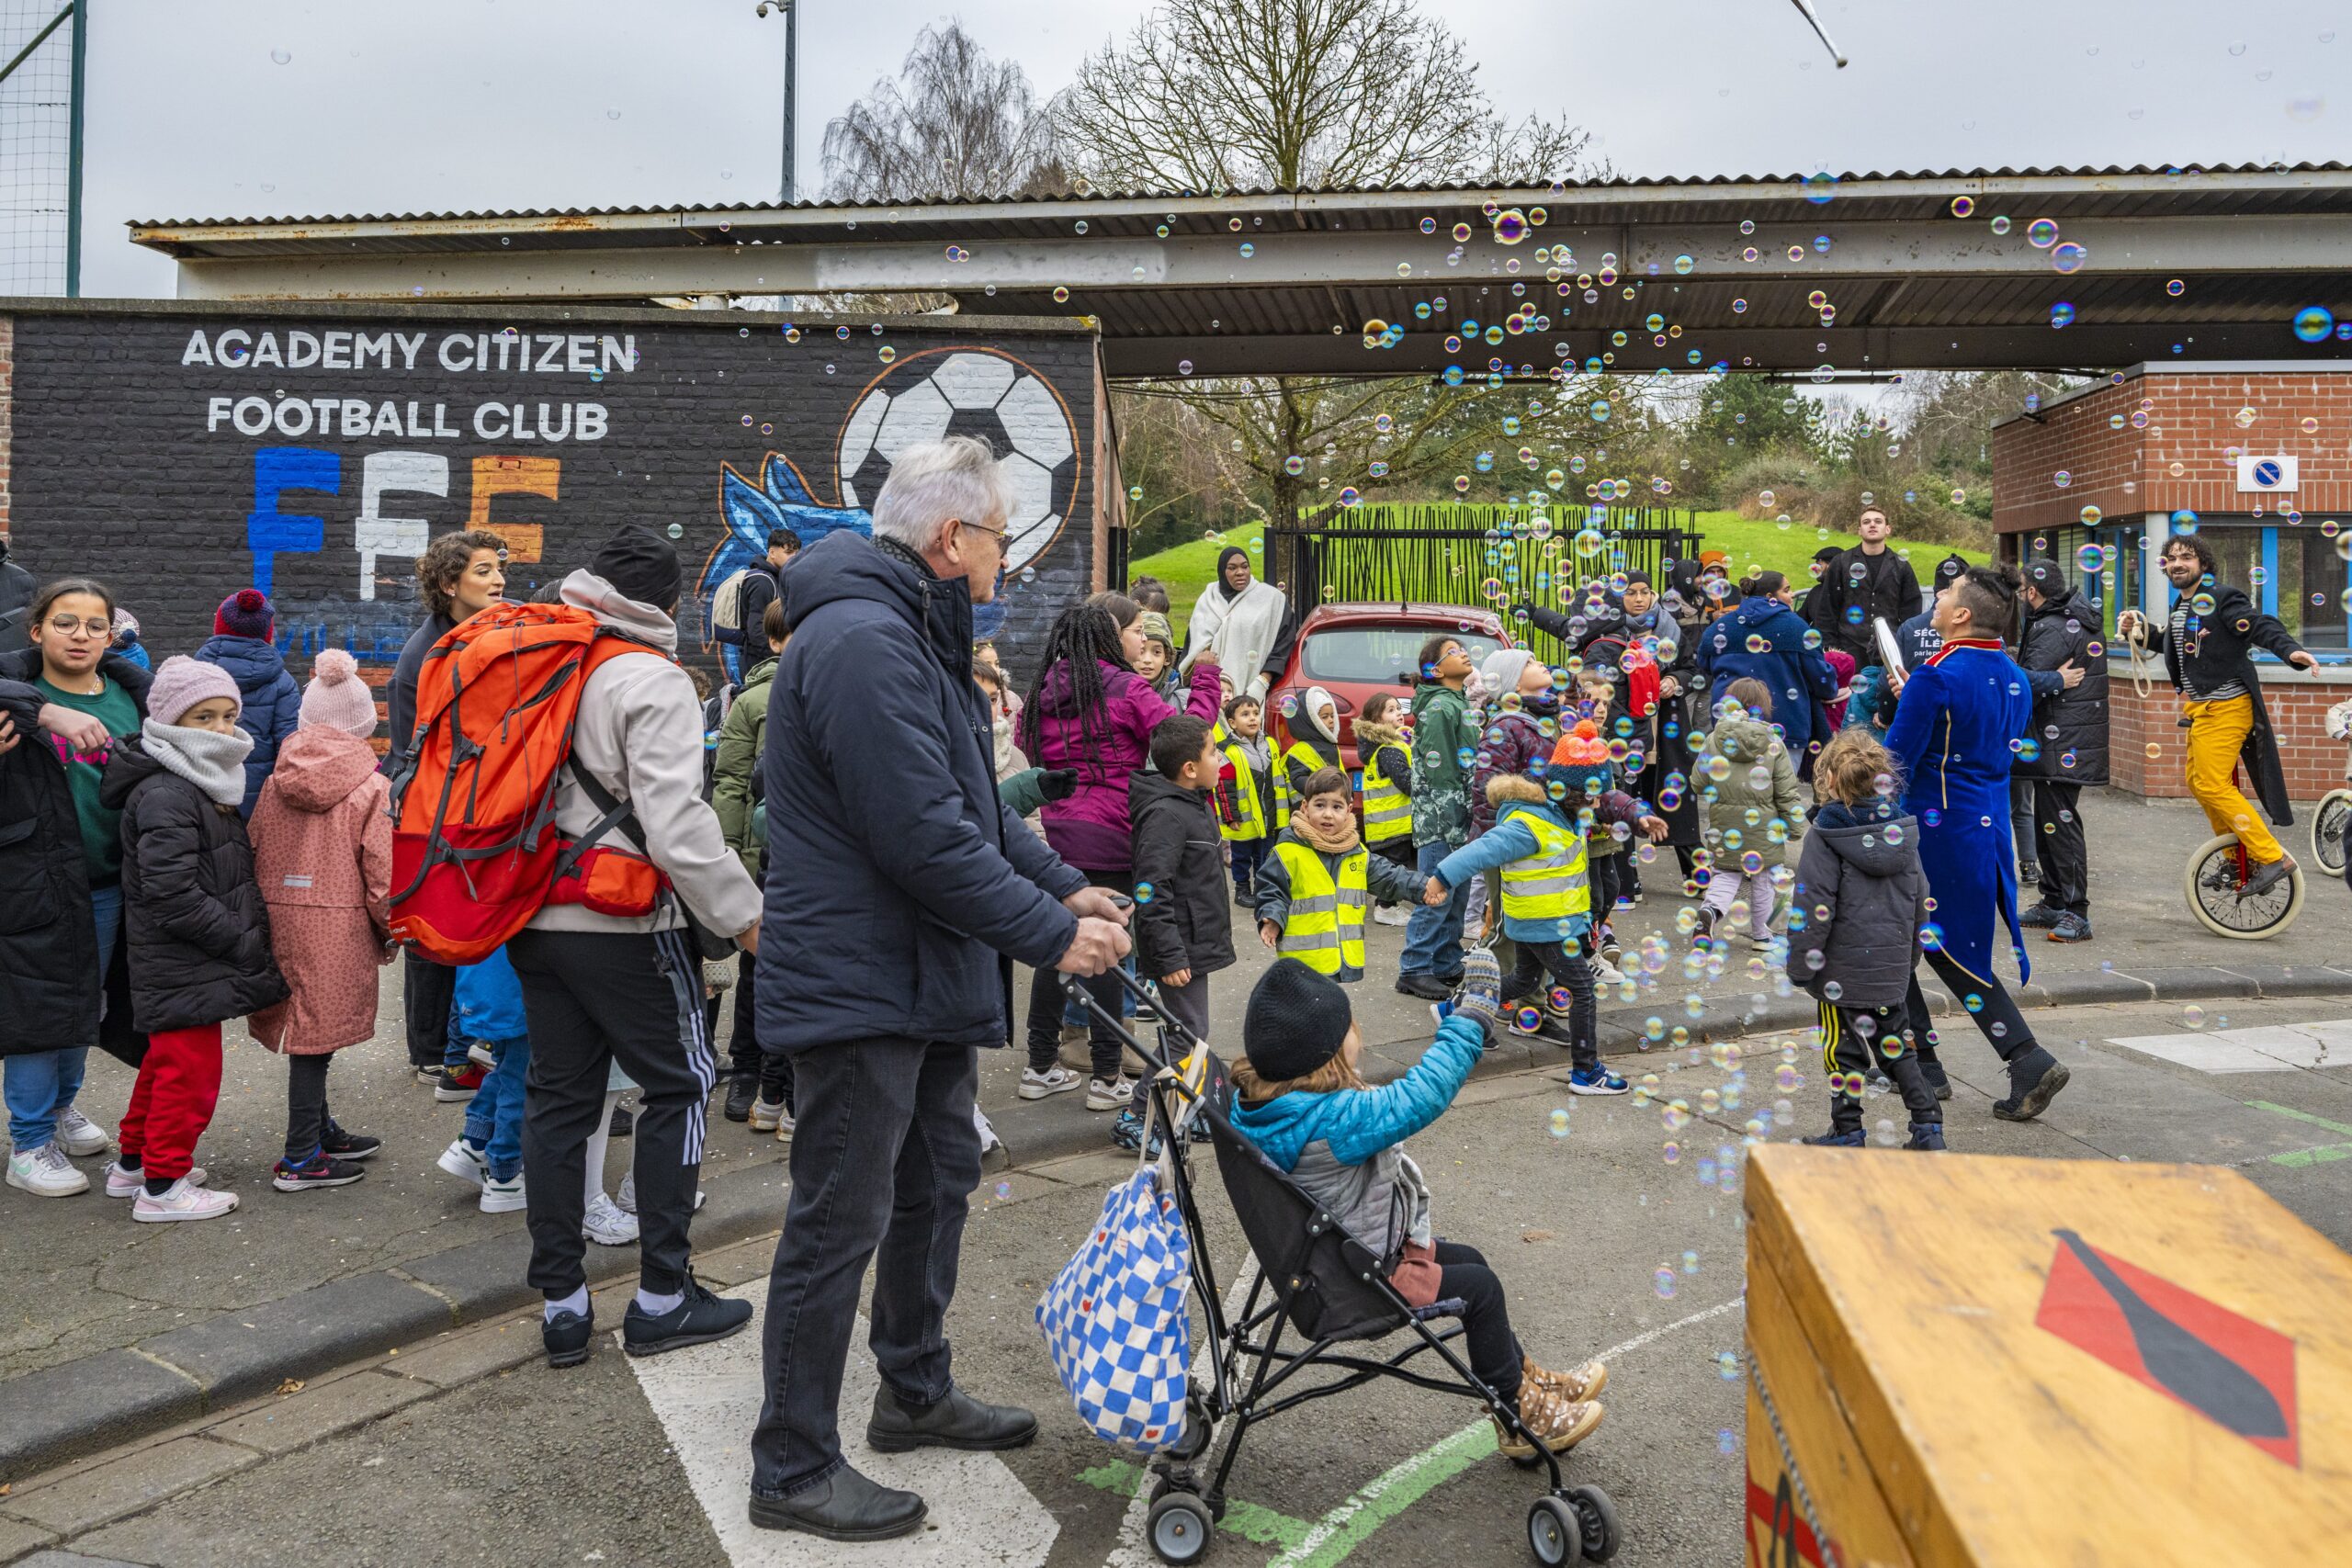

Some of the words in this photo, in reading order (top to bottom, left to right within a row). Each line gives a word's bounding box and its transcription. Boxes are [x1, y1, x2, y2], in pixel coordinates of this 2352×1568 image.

[182, 329, 427, 369] ACADEMY
[438, 333, 636, 372] CITIZEN
[208, 396, 460, 437] FOOTBALL
[473, 401, 609, 442] CLUB
